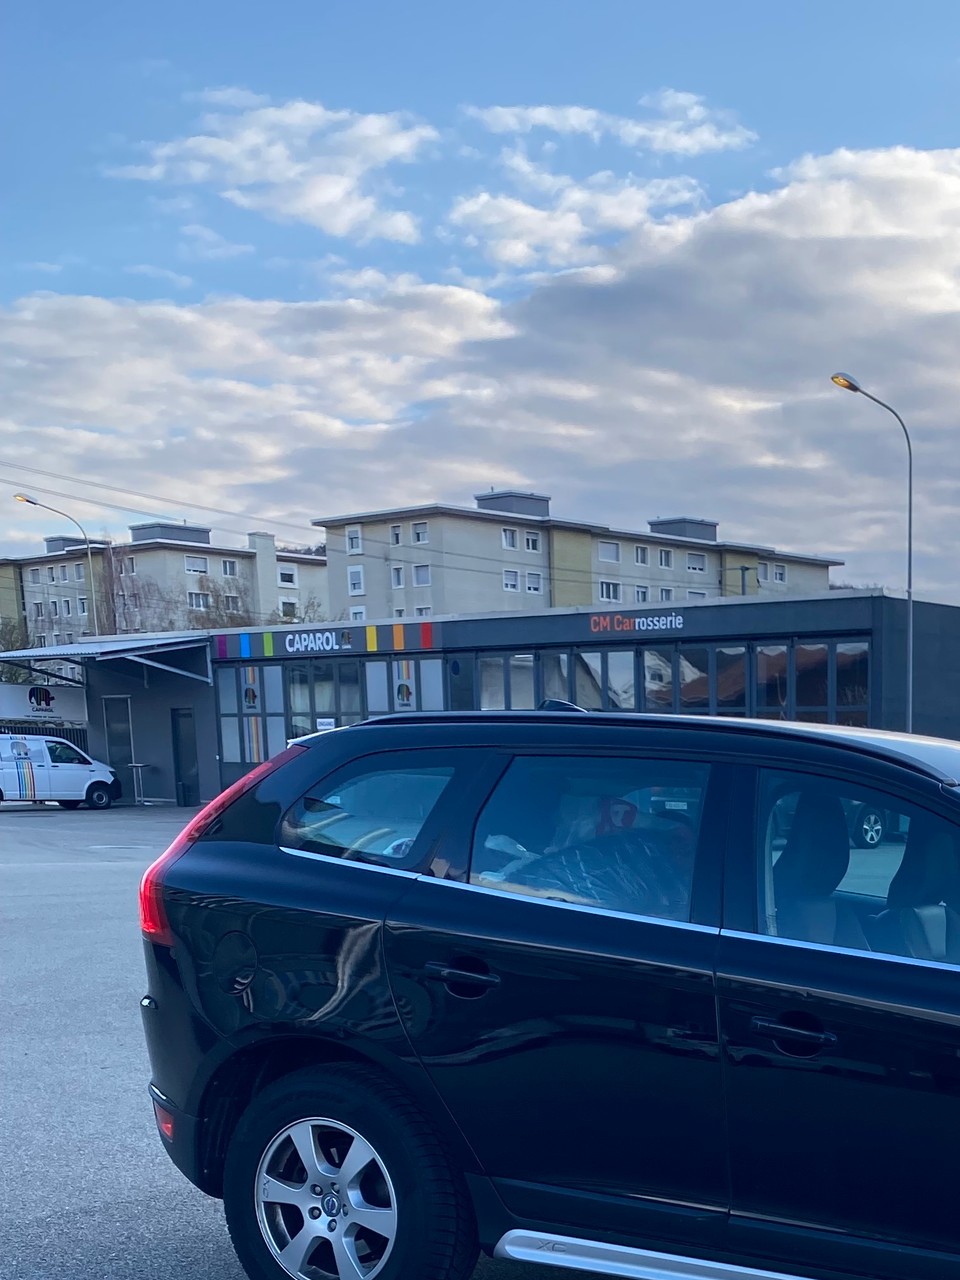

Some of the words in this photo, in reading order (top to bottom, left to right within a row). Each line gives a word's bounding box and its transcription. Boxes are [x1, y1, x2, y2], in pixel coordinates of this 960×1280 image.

[590, 615, 611, 632] CM
[614, 612, 684, 631] Carrosserie
[285, 631, 340, 653] CAPAROL
[536, 1240, 567, 1253] XC
